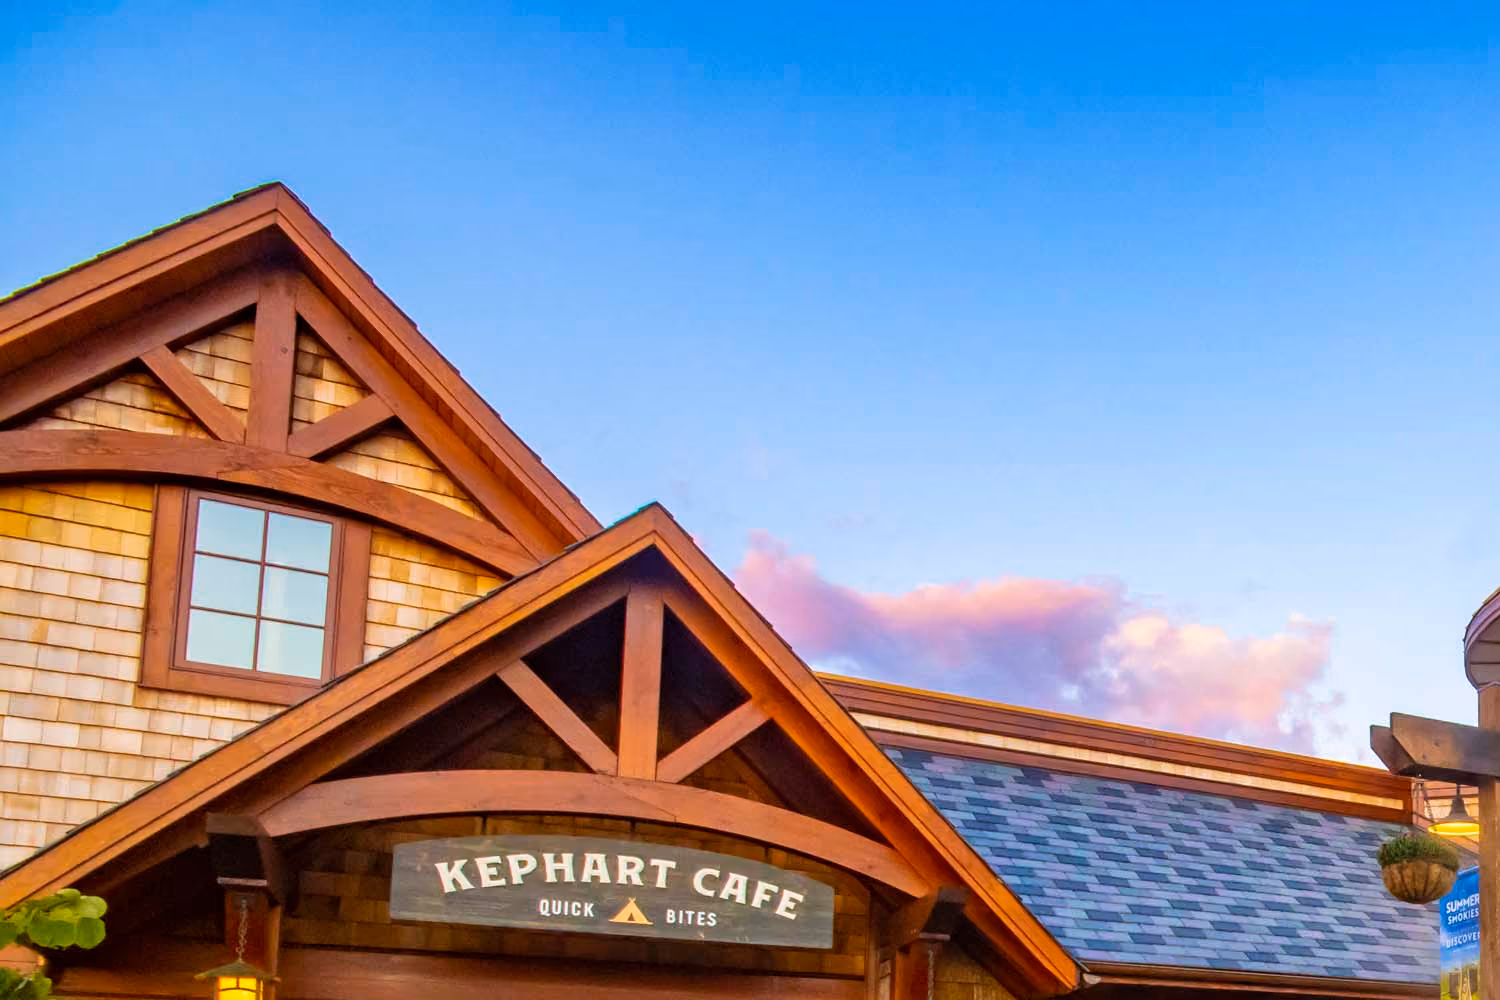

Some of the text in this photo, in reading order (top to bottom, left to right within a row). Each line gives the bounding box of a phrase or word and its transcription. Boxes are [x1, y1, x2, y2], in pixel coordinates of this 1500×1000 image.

[434, 852, 805, 920] KEPHART CAFE
[538, 899, 718, 927] QUICK BITES
[1446, 893, 1480, 914] SUMMER
[1447, 908, 1480, 925] SMOKIES
